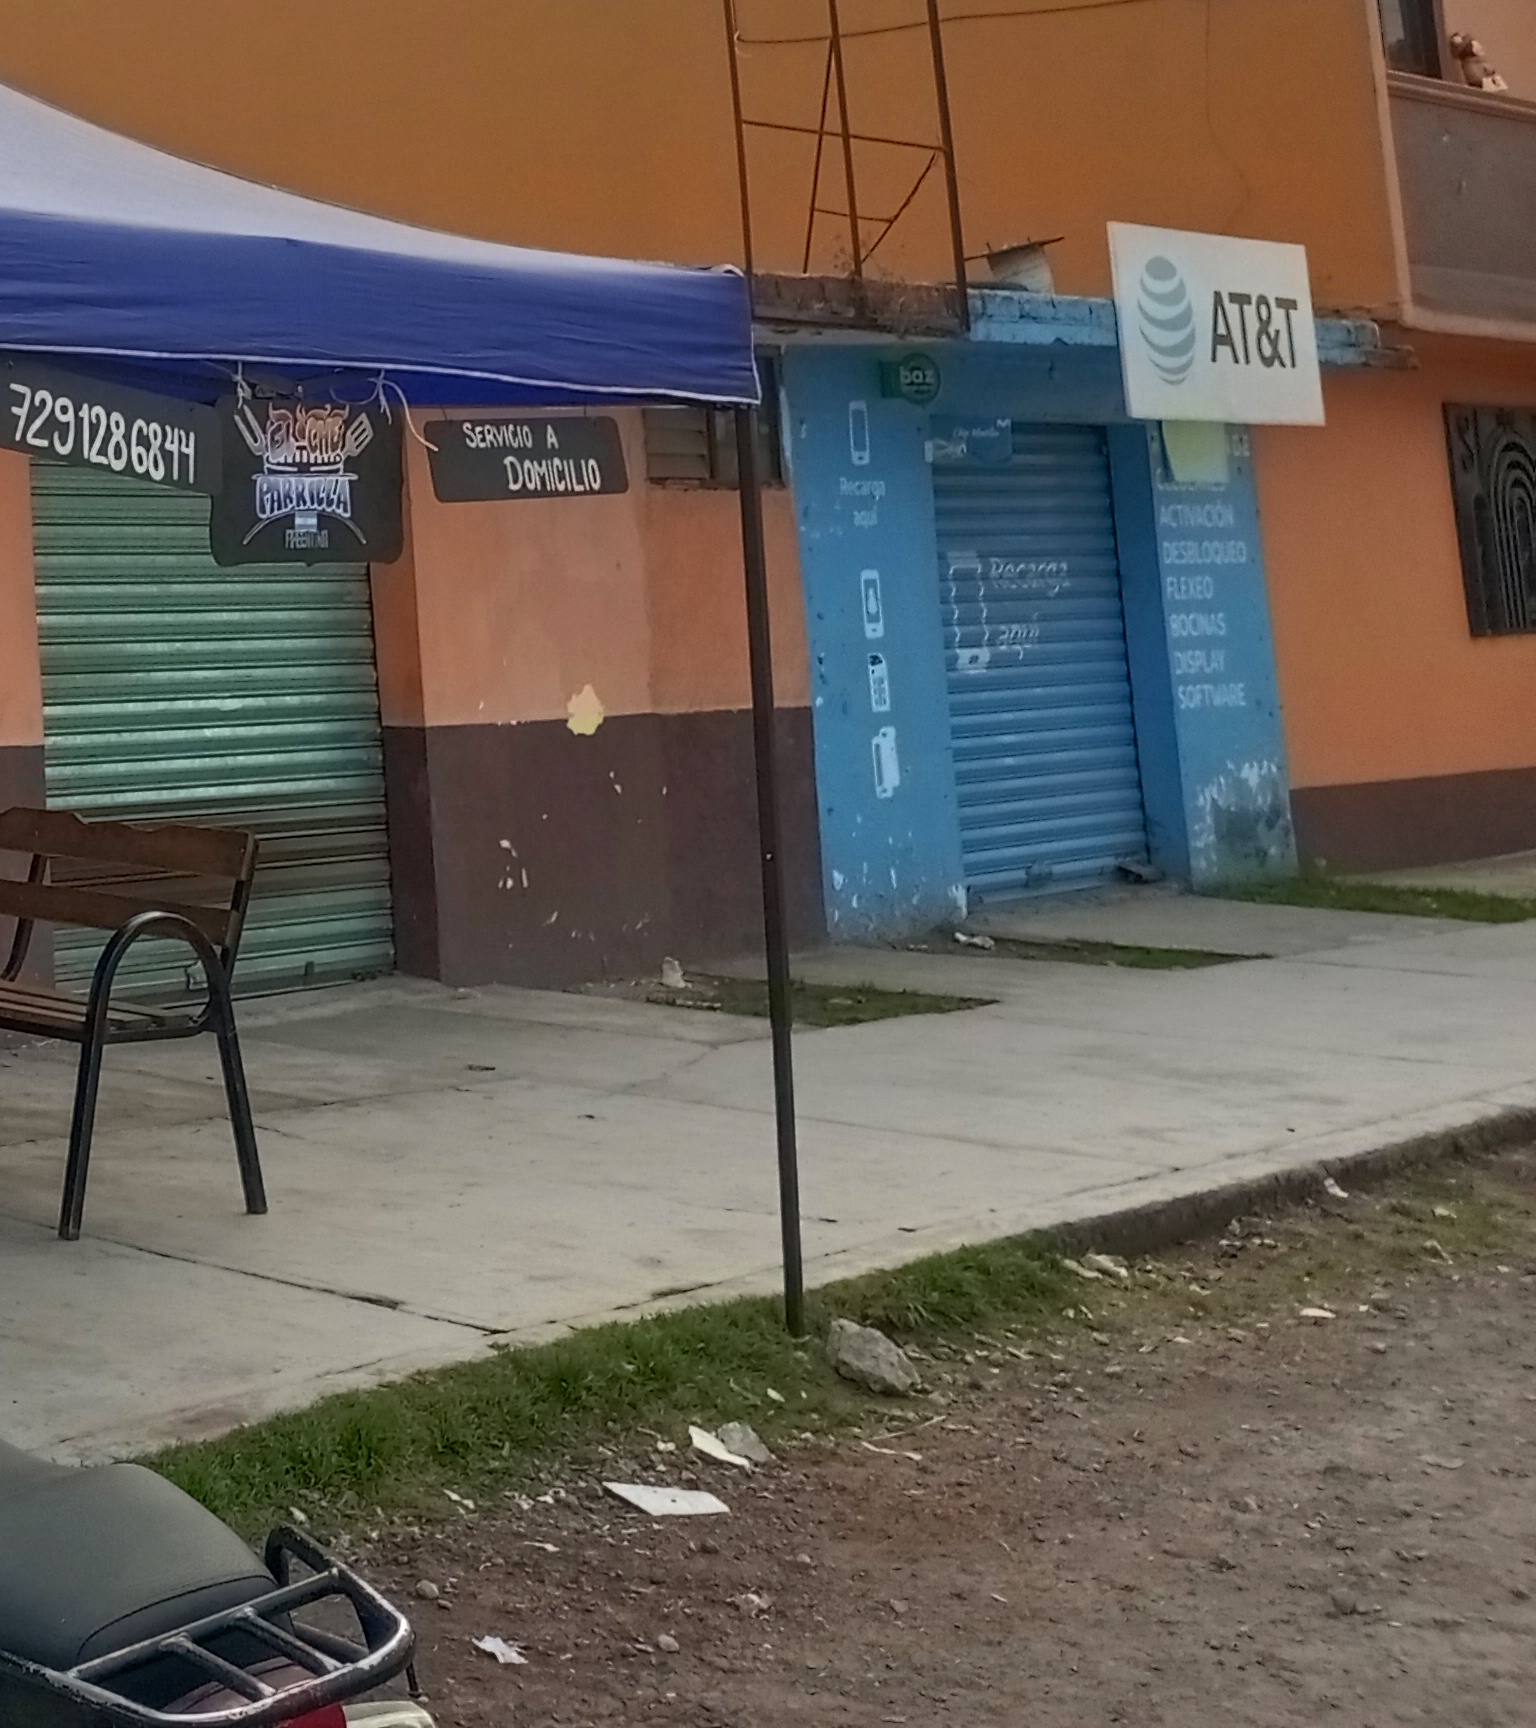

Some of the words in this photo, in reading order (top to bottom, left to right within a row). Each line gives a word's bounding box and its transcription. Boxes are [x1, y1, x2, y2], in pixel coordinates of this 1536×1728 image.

[1211, 290, 1298, 369] AT&T
[462, 422, 533, 449] SERVICIO
[546, 424, 559, 449] A
[503, 455, 602, 492] DOMICILIO
[256, 477, 352, 519] PARRILLA
[1161, 540, 1247, 565] DESBLOQUEO
[988, 556, 1072, 598] Recarga
[1169, 612, 1226, 638] BOCINAS
[1173, 649, 1226, 675] DISPLAY
[1178, 681, 1247, 710] SOFTWARE
